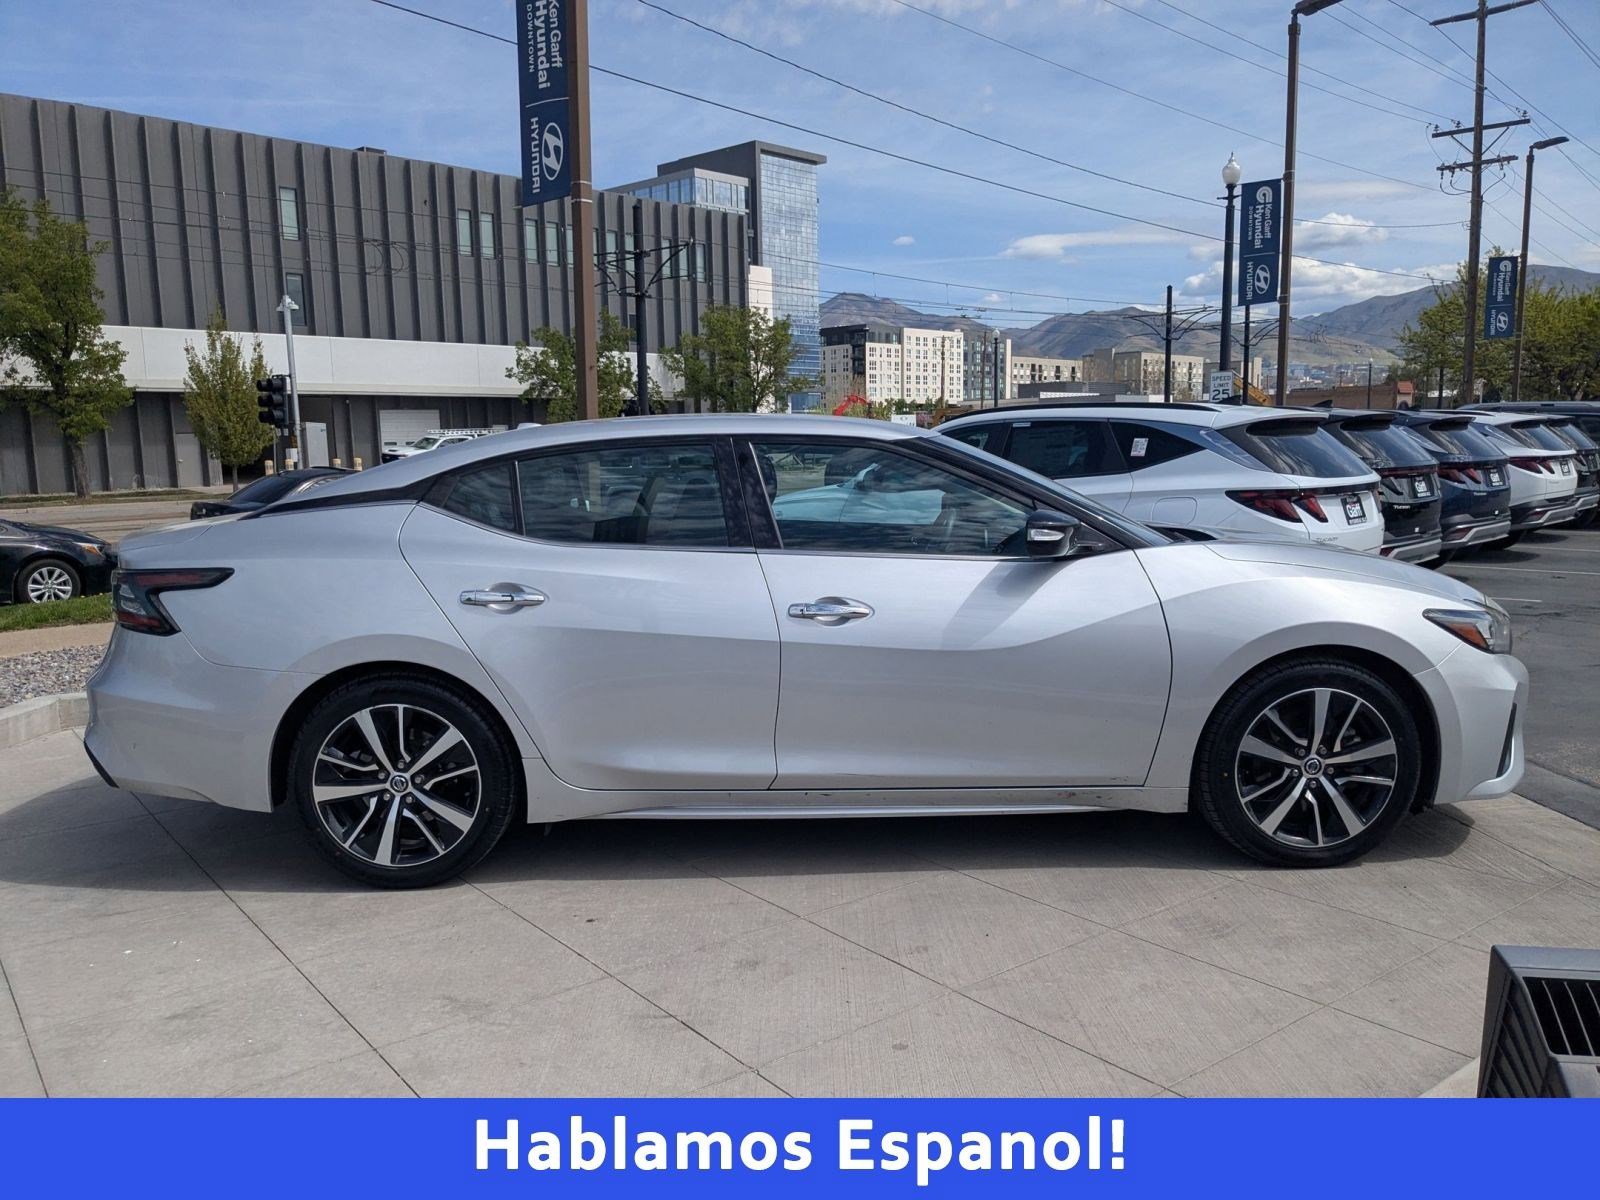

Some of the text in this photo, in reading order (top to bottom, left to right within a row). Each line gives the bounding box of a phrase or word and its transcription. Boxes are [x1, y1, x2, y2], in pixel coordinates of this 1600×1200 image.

[527, 4, 535, 73] DOWNTOWN
[535, 0, 551, 89] Hyundai
[549, 0, 563, 68] Ken Garff
[530, 117, 541, 193] HYUNDAI
[1254, 205, 1264, 249] Hyundai
[1264, 203, 1273, 219] Ken
[1246, 262, 1254, 300] HYUNDAI
[1212, 389, 1229, 400] 25
